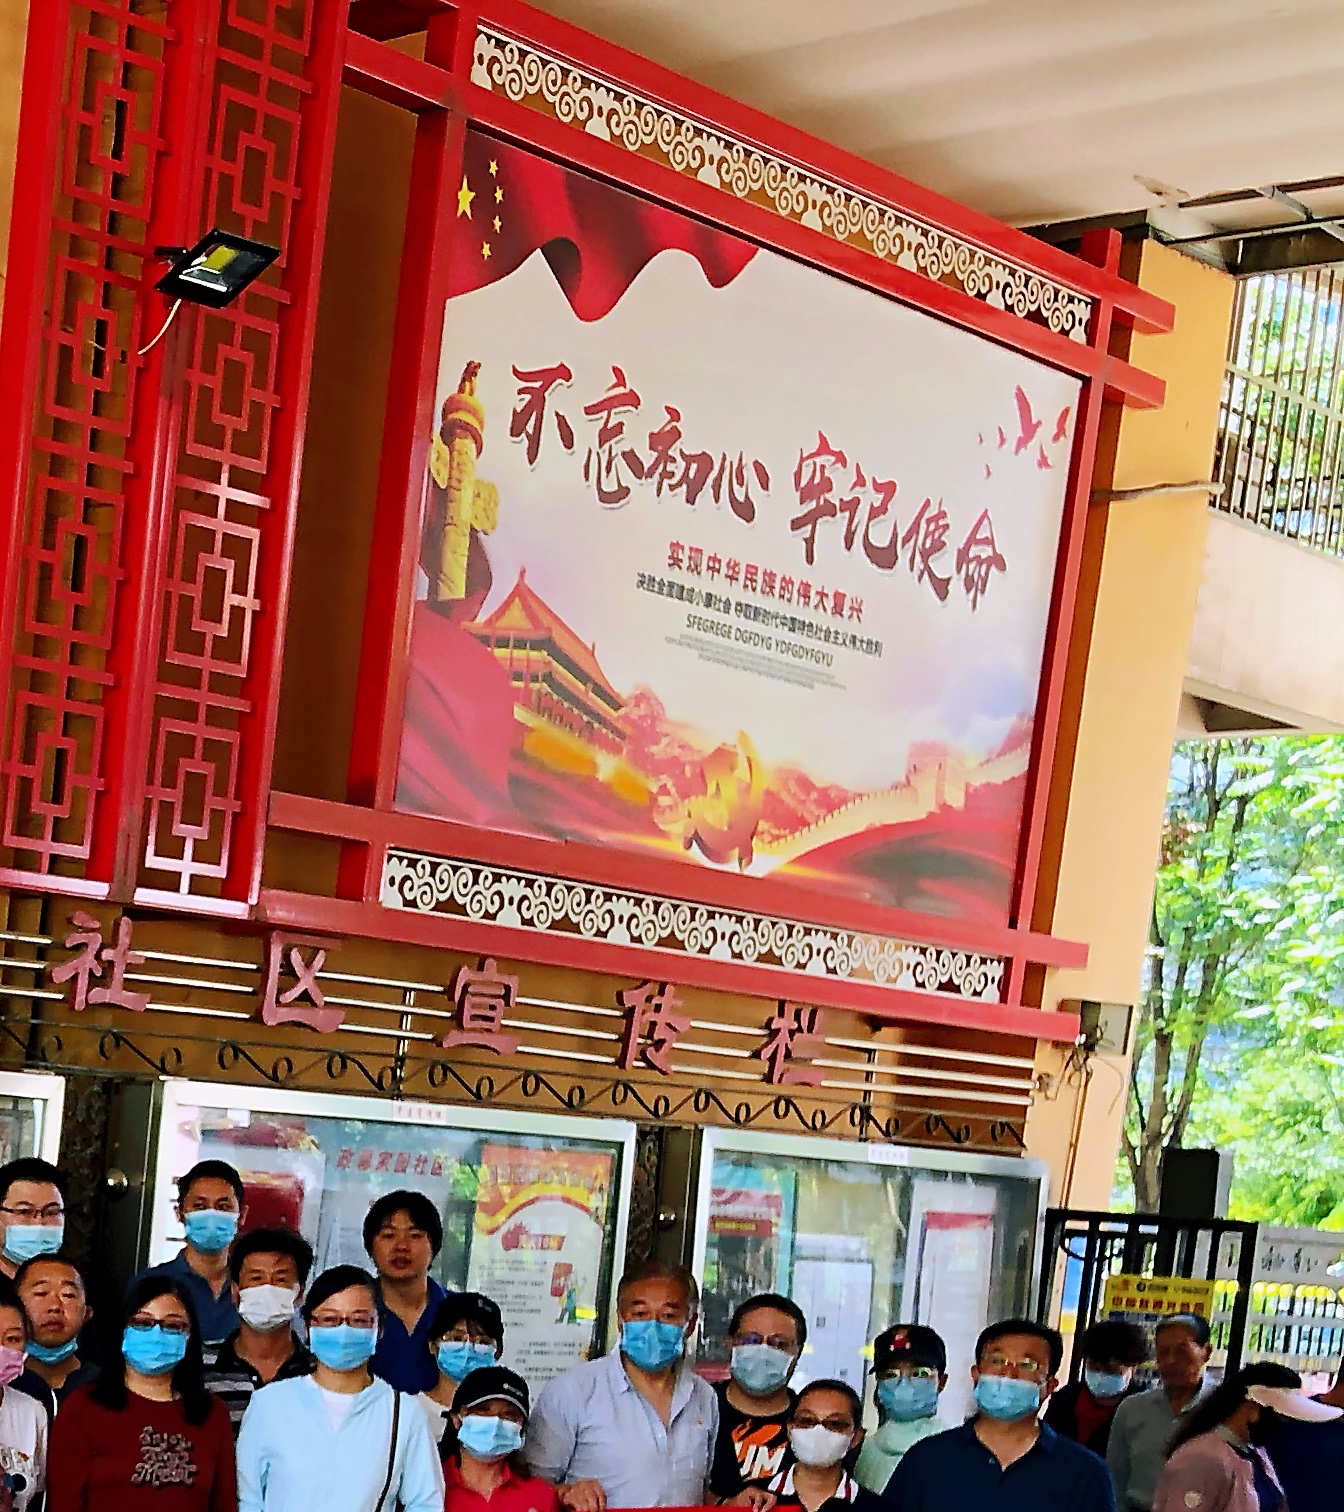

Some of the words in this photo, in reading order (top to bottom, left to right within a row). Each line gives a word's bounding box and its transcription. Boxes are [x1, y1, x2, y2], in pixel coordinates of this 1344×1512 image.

[509, 361, 770, 524] 不忘初心
[788, 430, 1008, 611] 牢记使命
[667, 540, 863, 622] 实现中华民族的伟大复兴
